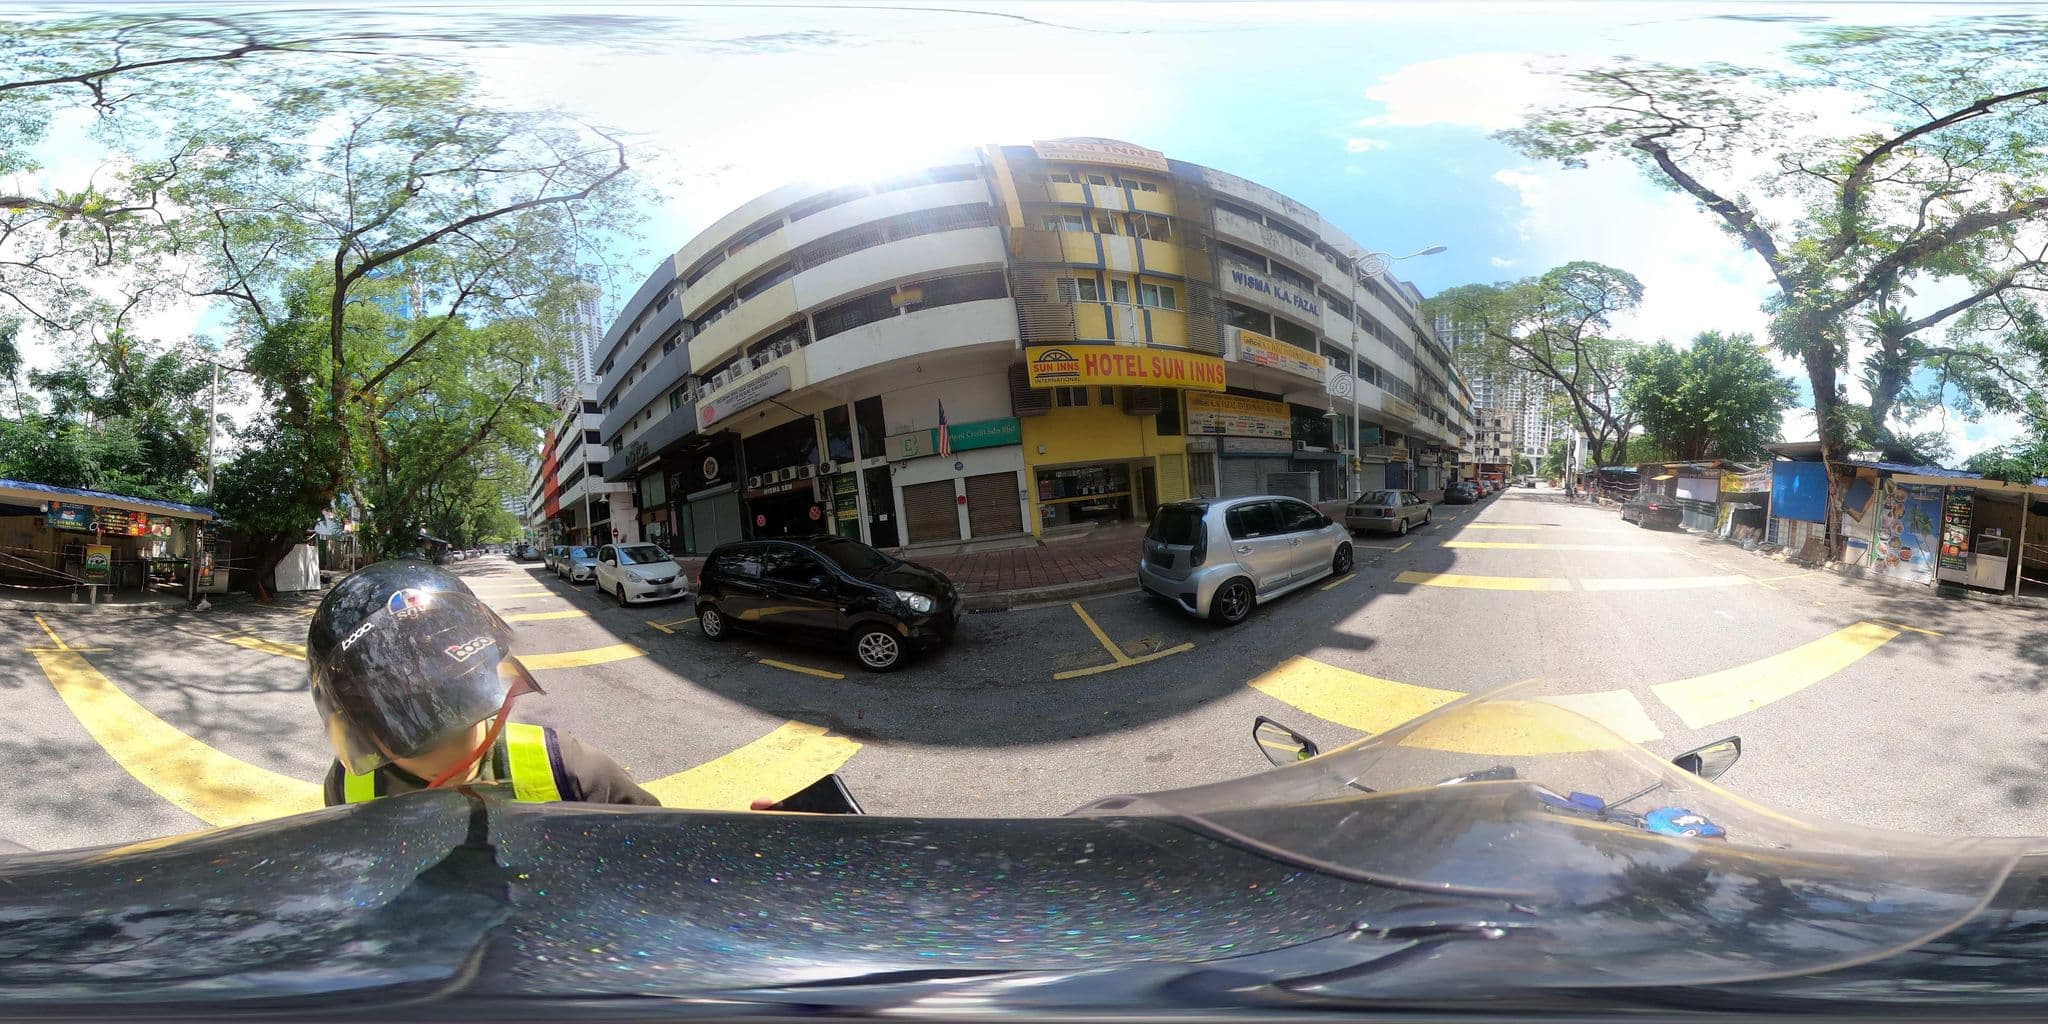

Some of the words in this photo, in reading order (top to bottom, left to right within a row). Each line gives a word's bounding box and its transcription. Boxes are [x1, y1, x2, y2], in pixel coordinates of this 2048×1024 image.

[1231, 270, 1271, 295] WISMA
[1293, 293, 1319, 317] FAZAL
[1033, 363, 1053, 373] SUN
[1057, 361, 1080, 371] INNS
[1084, 353, 1148, 377] HOTEL
[1152, 355, 1185, 380] SUN
[1190, 360, 1224, 384] INNS
